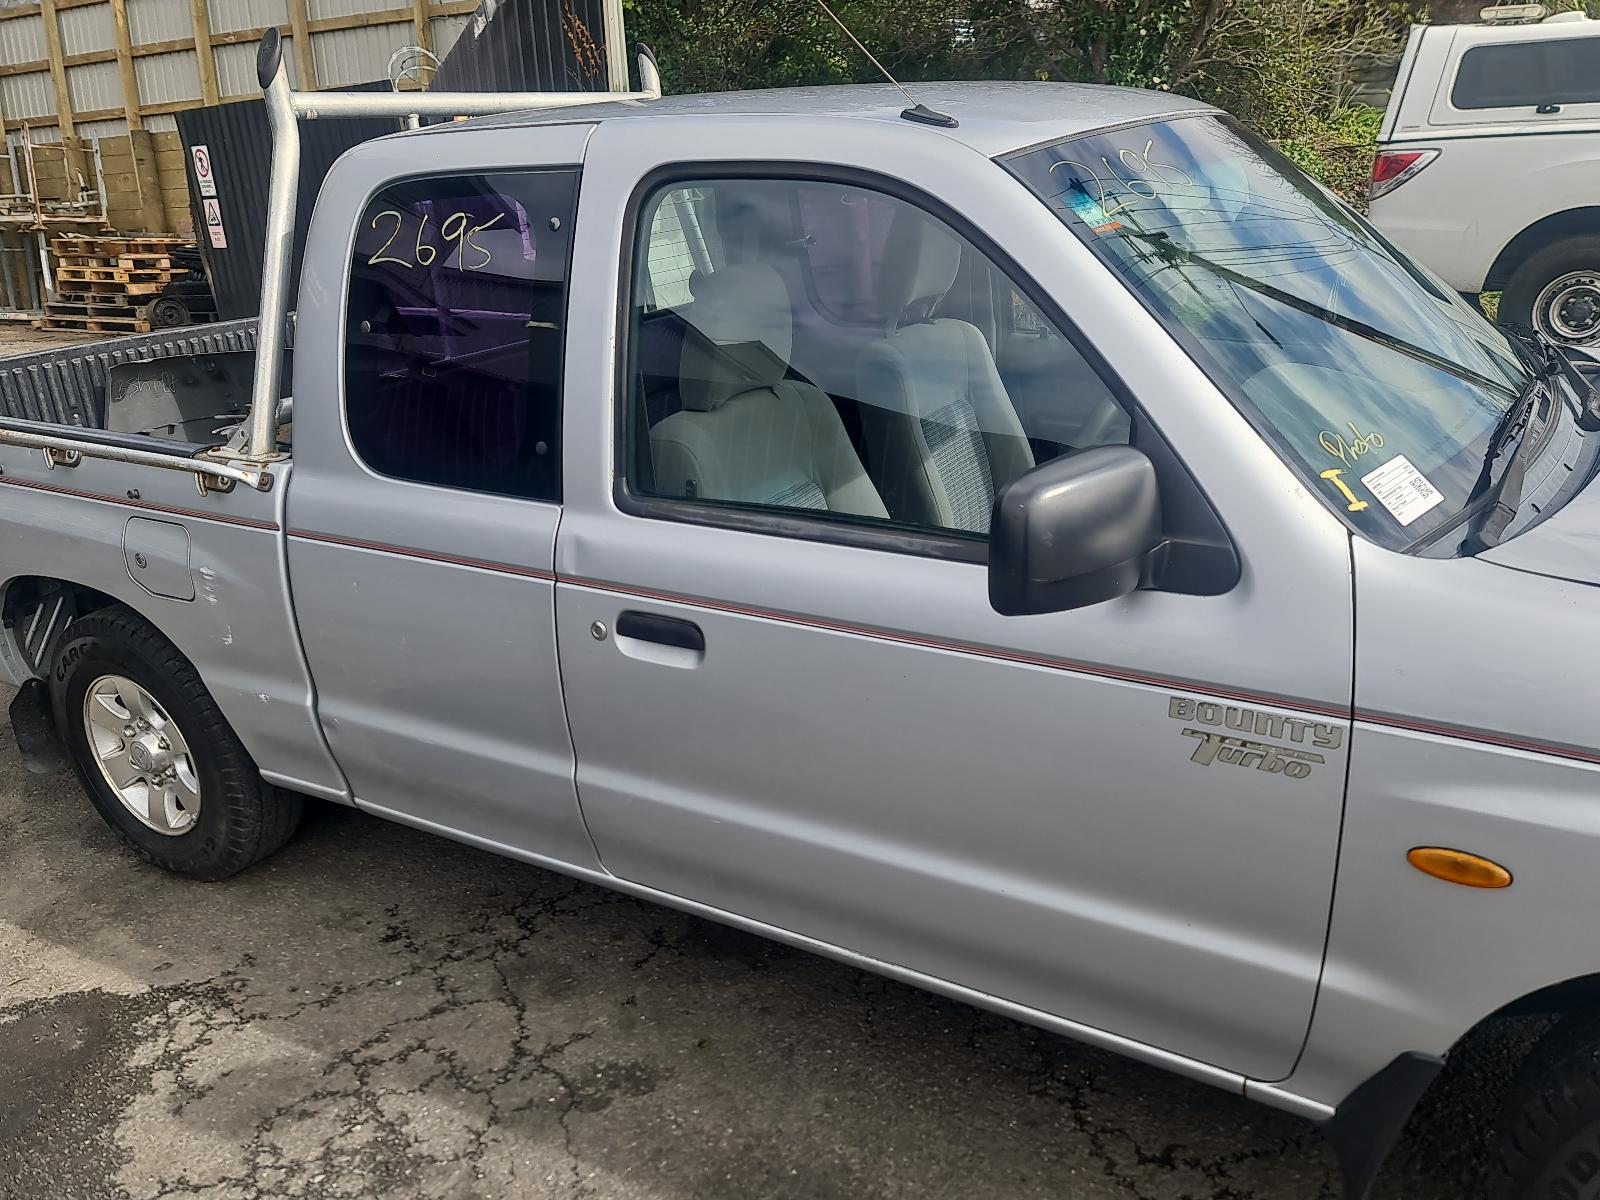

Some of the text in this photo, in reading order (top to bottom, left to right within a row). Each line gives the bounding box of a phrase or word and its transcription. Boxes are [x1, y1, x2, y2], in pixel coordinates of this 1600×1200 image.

[1049, 139, 1194, 218] 2695
[367, 210, 505, 273] 2695
[1168, 696, 1343, 750] BOUNTY
[1181, 727, 1326, 779] Turbo
